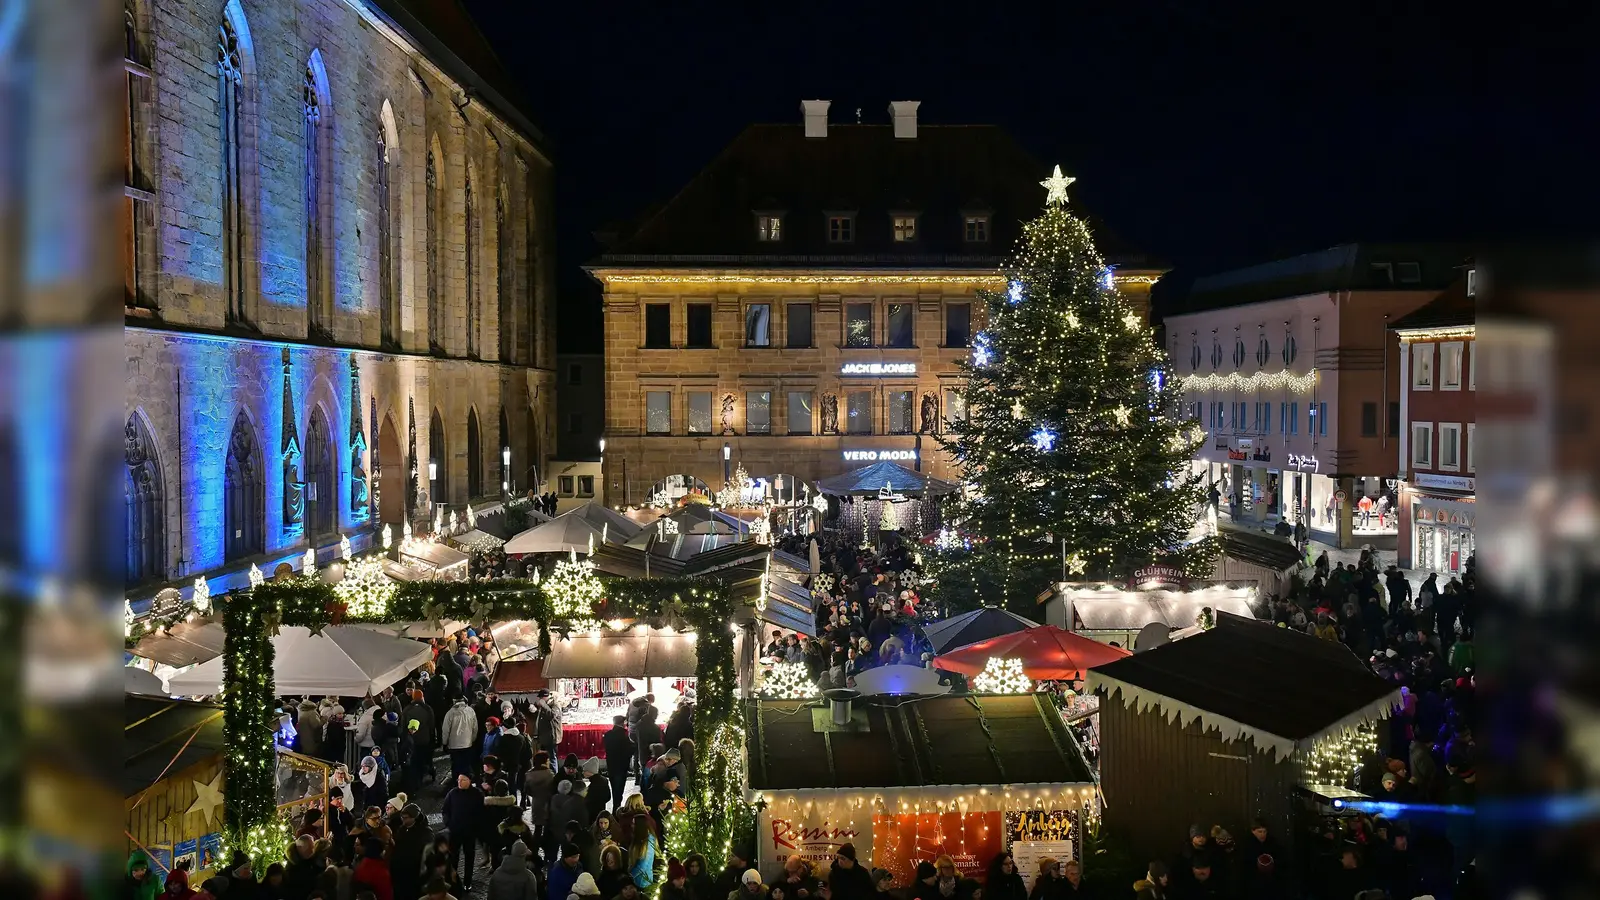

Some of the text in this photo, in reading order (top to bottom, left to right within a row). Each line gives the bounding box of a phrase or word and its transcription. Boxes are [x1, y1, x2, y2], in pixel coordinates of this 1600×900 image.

[843, 450, 917, 460] VERO MODA
[1134, 566, 1184, 578] GLÜHWEIN
[1015, 812, 1070, 836] Amberg
[771, 818, 860, 850] Rossini
